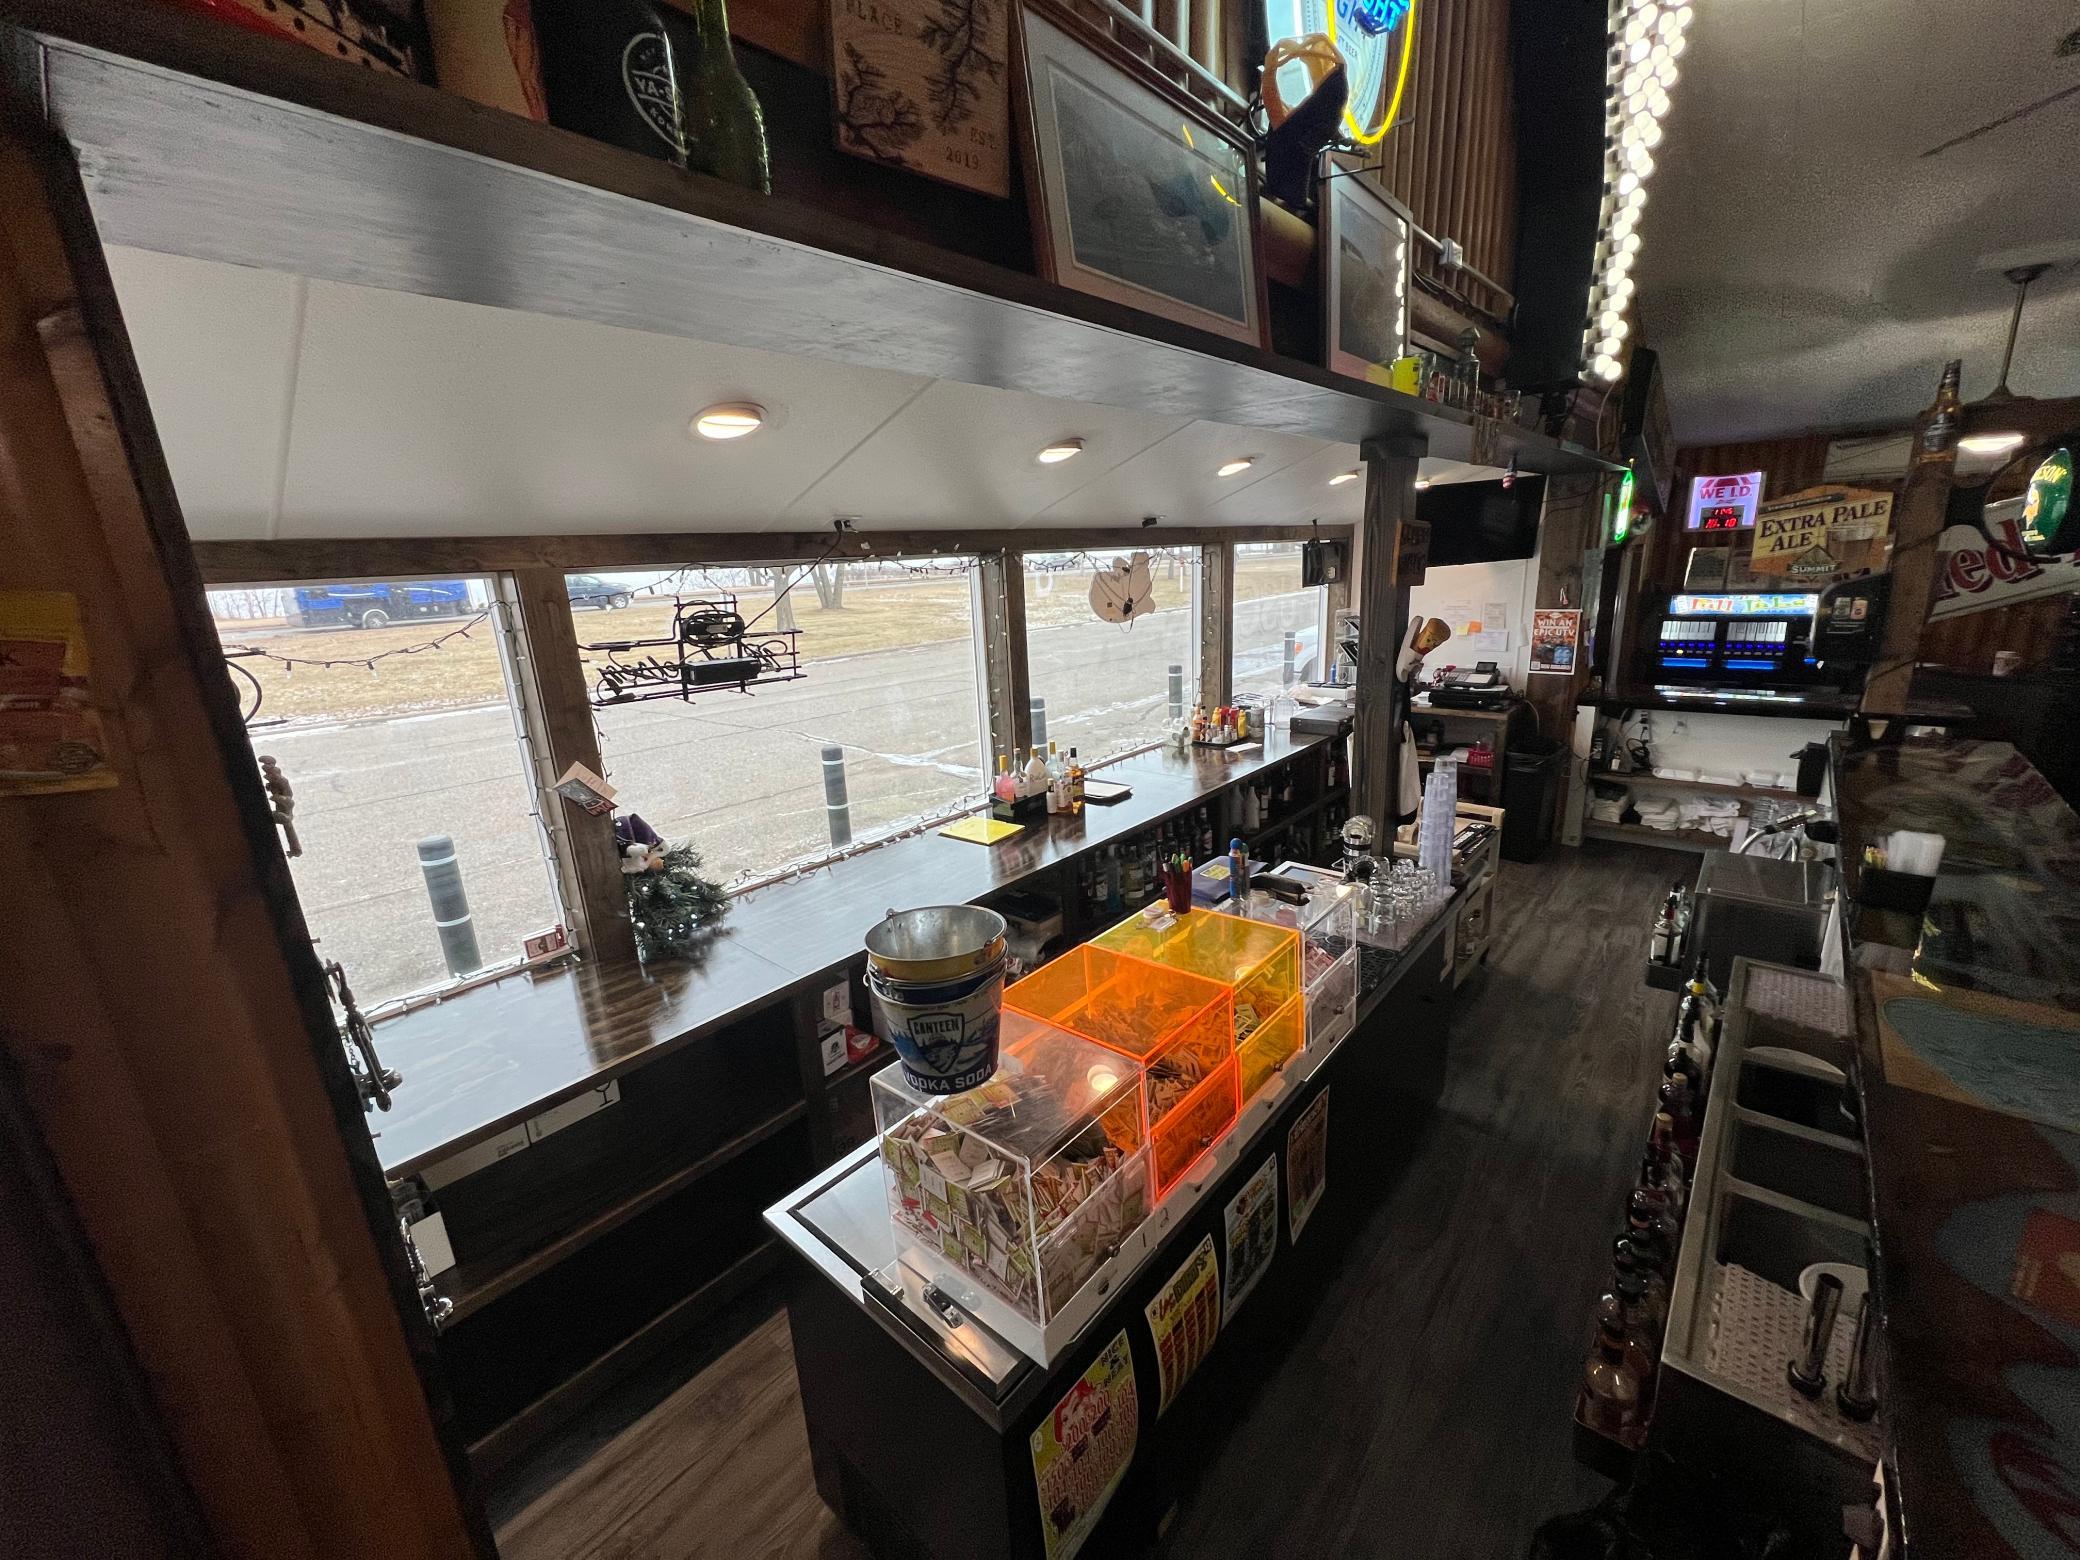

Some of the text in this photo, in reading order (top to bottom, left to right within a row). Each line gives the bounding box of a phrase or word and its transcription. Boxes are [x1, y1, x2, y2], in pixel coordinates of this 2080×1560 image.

[1700, 487, 1725, 499] WE
[1760, 512, 1826, 538] EXTRA
[1832, 500, 1888, 524] PALE
[1769, 532, 1814, 552] ALE
[1791, 564, 1836, 574] SUMMIT
[1538, 619, 1573, 627] WIN AN
[1556, 628, 1575, 636] UTV
[913, 1018, 960, 1036] CANTEEN
[904, 1063, 992, 1092] VODKA SODA
